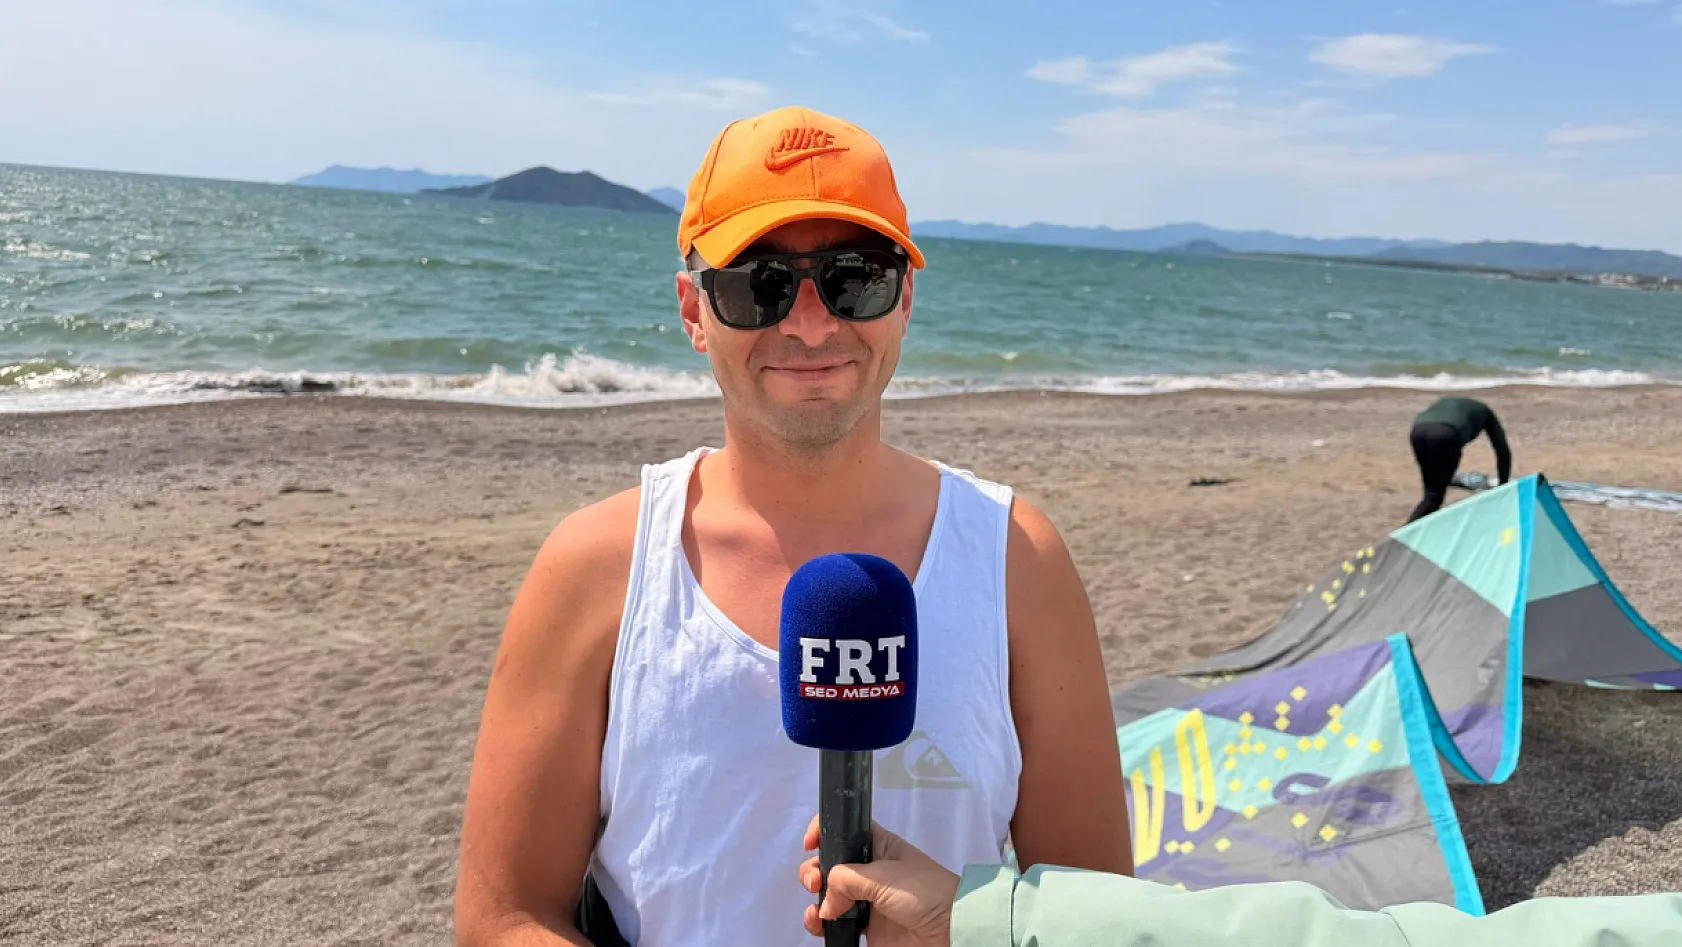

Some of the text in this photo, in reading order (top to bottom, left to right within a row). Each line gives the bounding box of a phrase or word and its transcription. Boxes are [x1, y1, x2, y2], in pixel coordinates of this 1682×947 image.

[775, 127, 836, 152] NIKE
[799, 635, 906, 685] FRT
[804, 684, 900, 699] SED MEDYA
